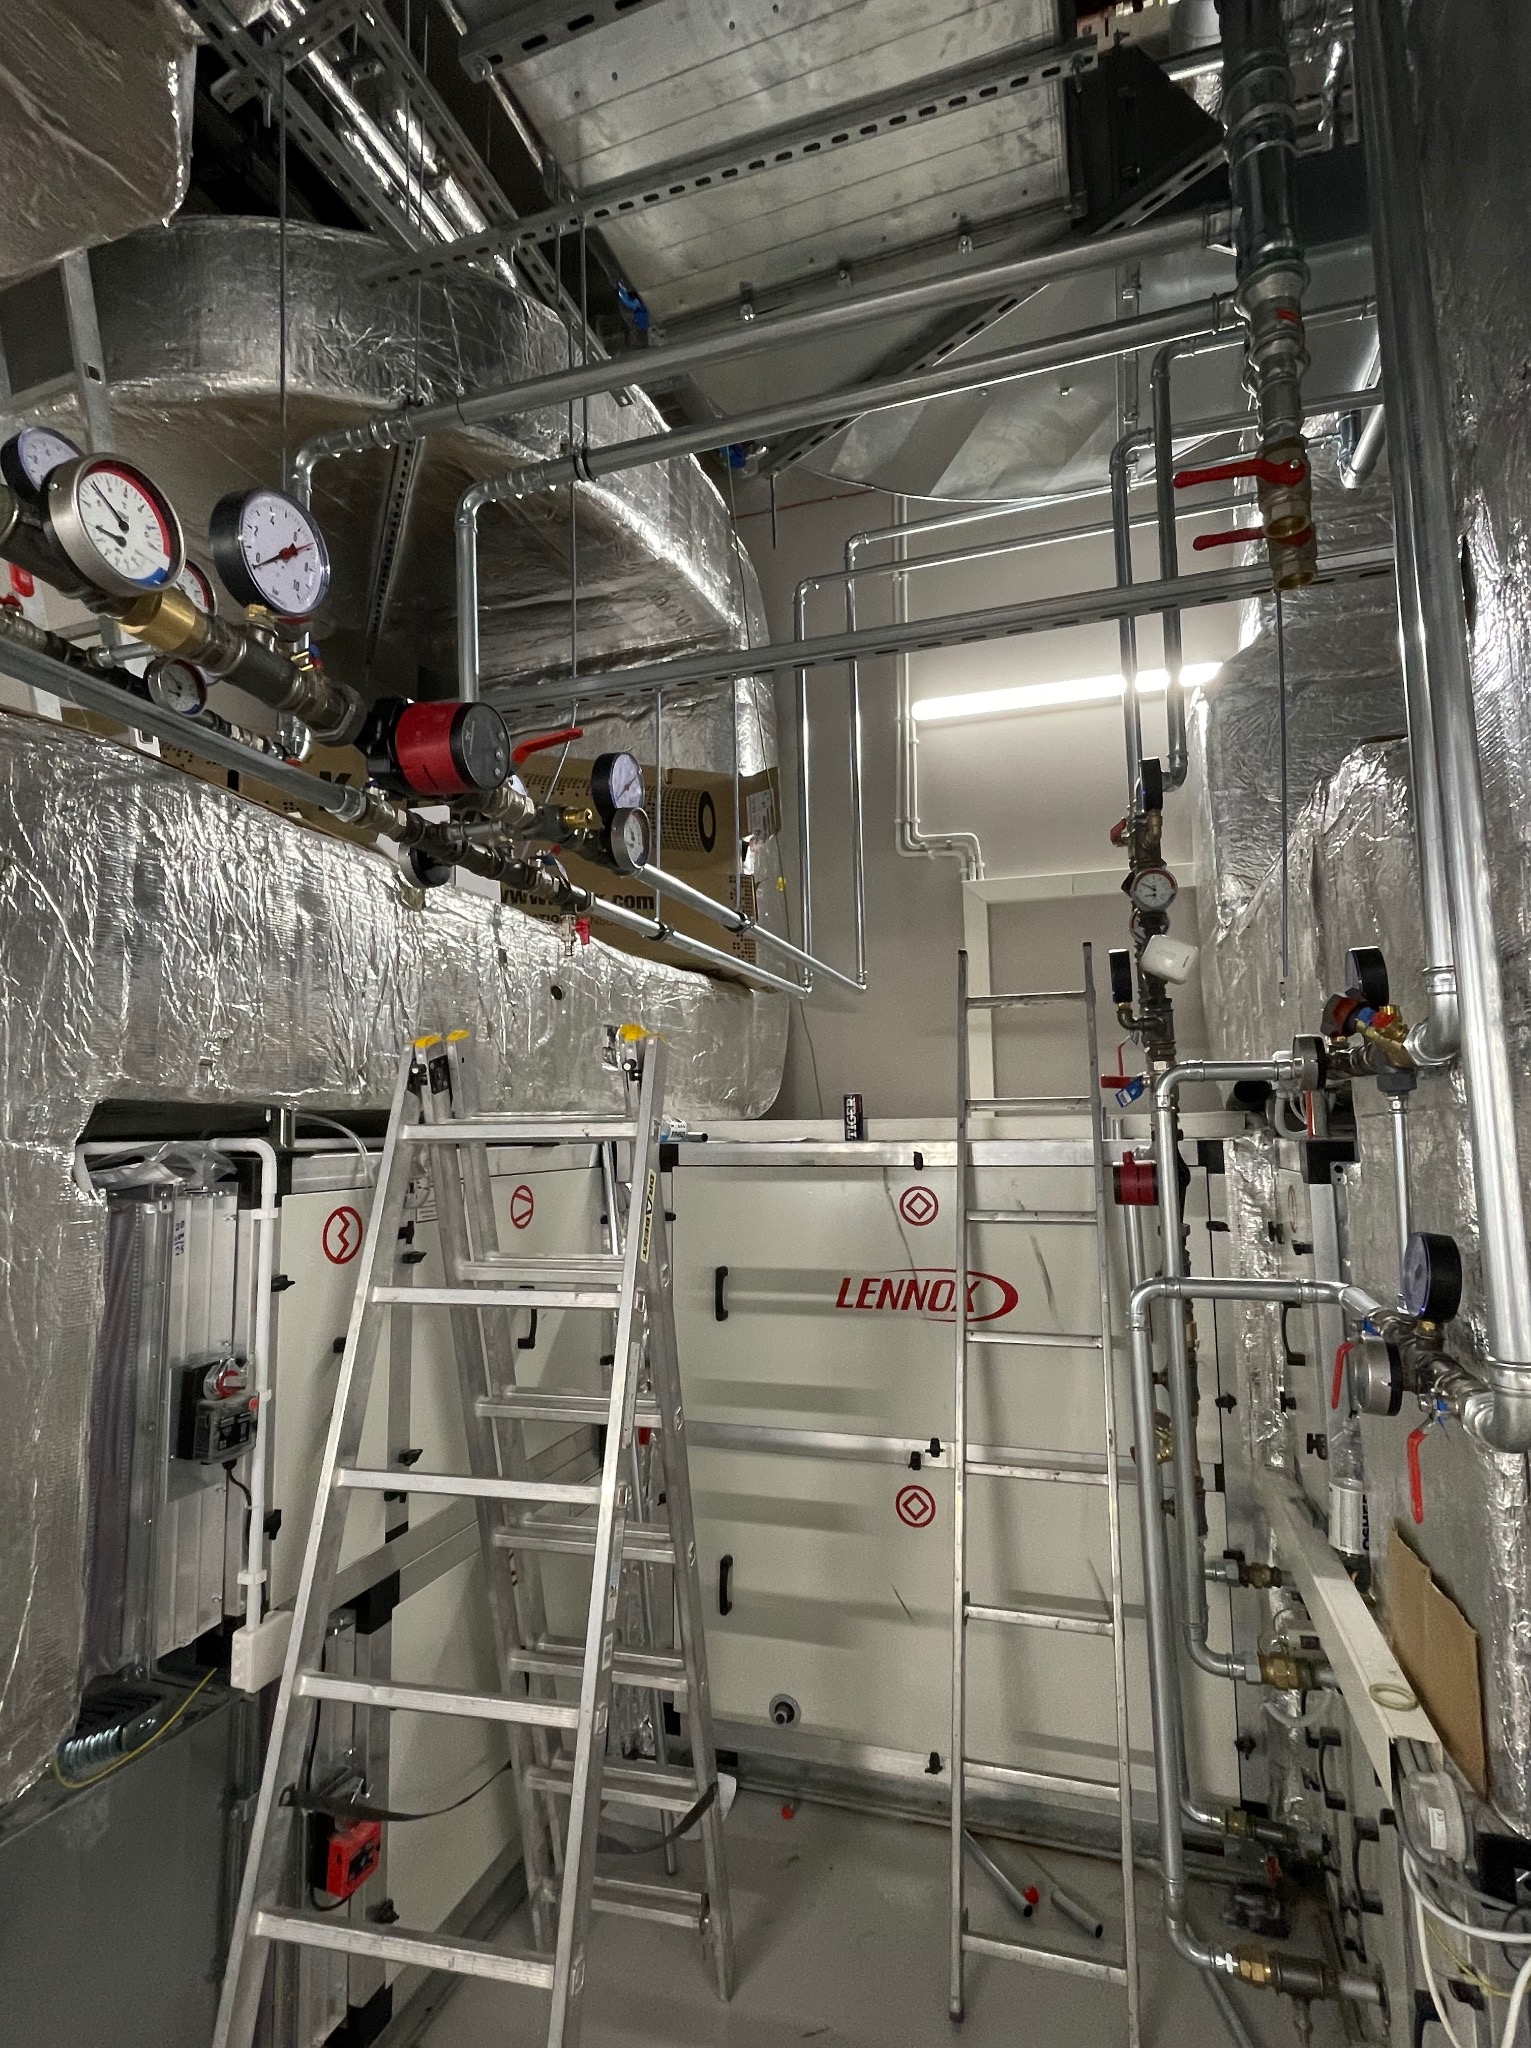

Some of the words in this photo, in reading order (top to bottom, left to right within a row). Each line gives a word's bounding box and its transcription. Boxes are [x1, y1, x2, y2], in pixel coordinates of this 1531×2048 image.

[253, 525, 259, 537] 2
[255, 552, 261, 563] 0
[292, 579, 300, 592] 10
[846, 1096, 857, 1139] TIGER
[641, 1173, 656, 1260] DRABEST
[835, 1277, 981, 1313] LENNOX
